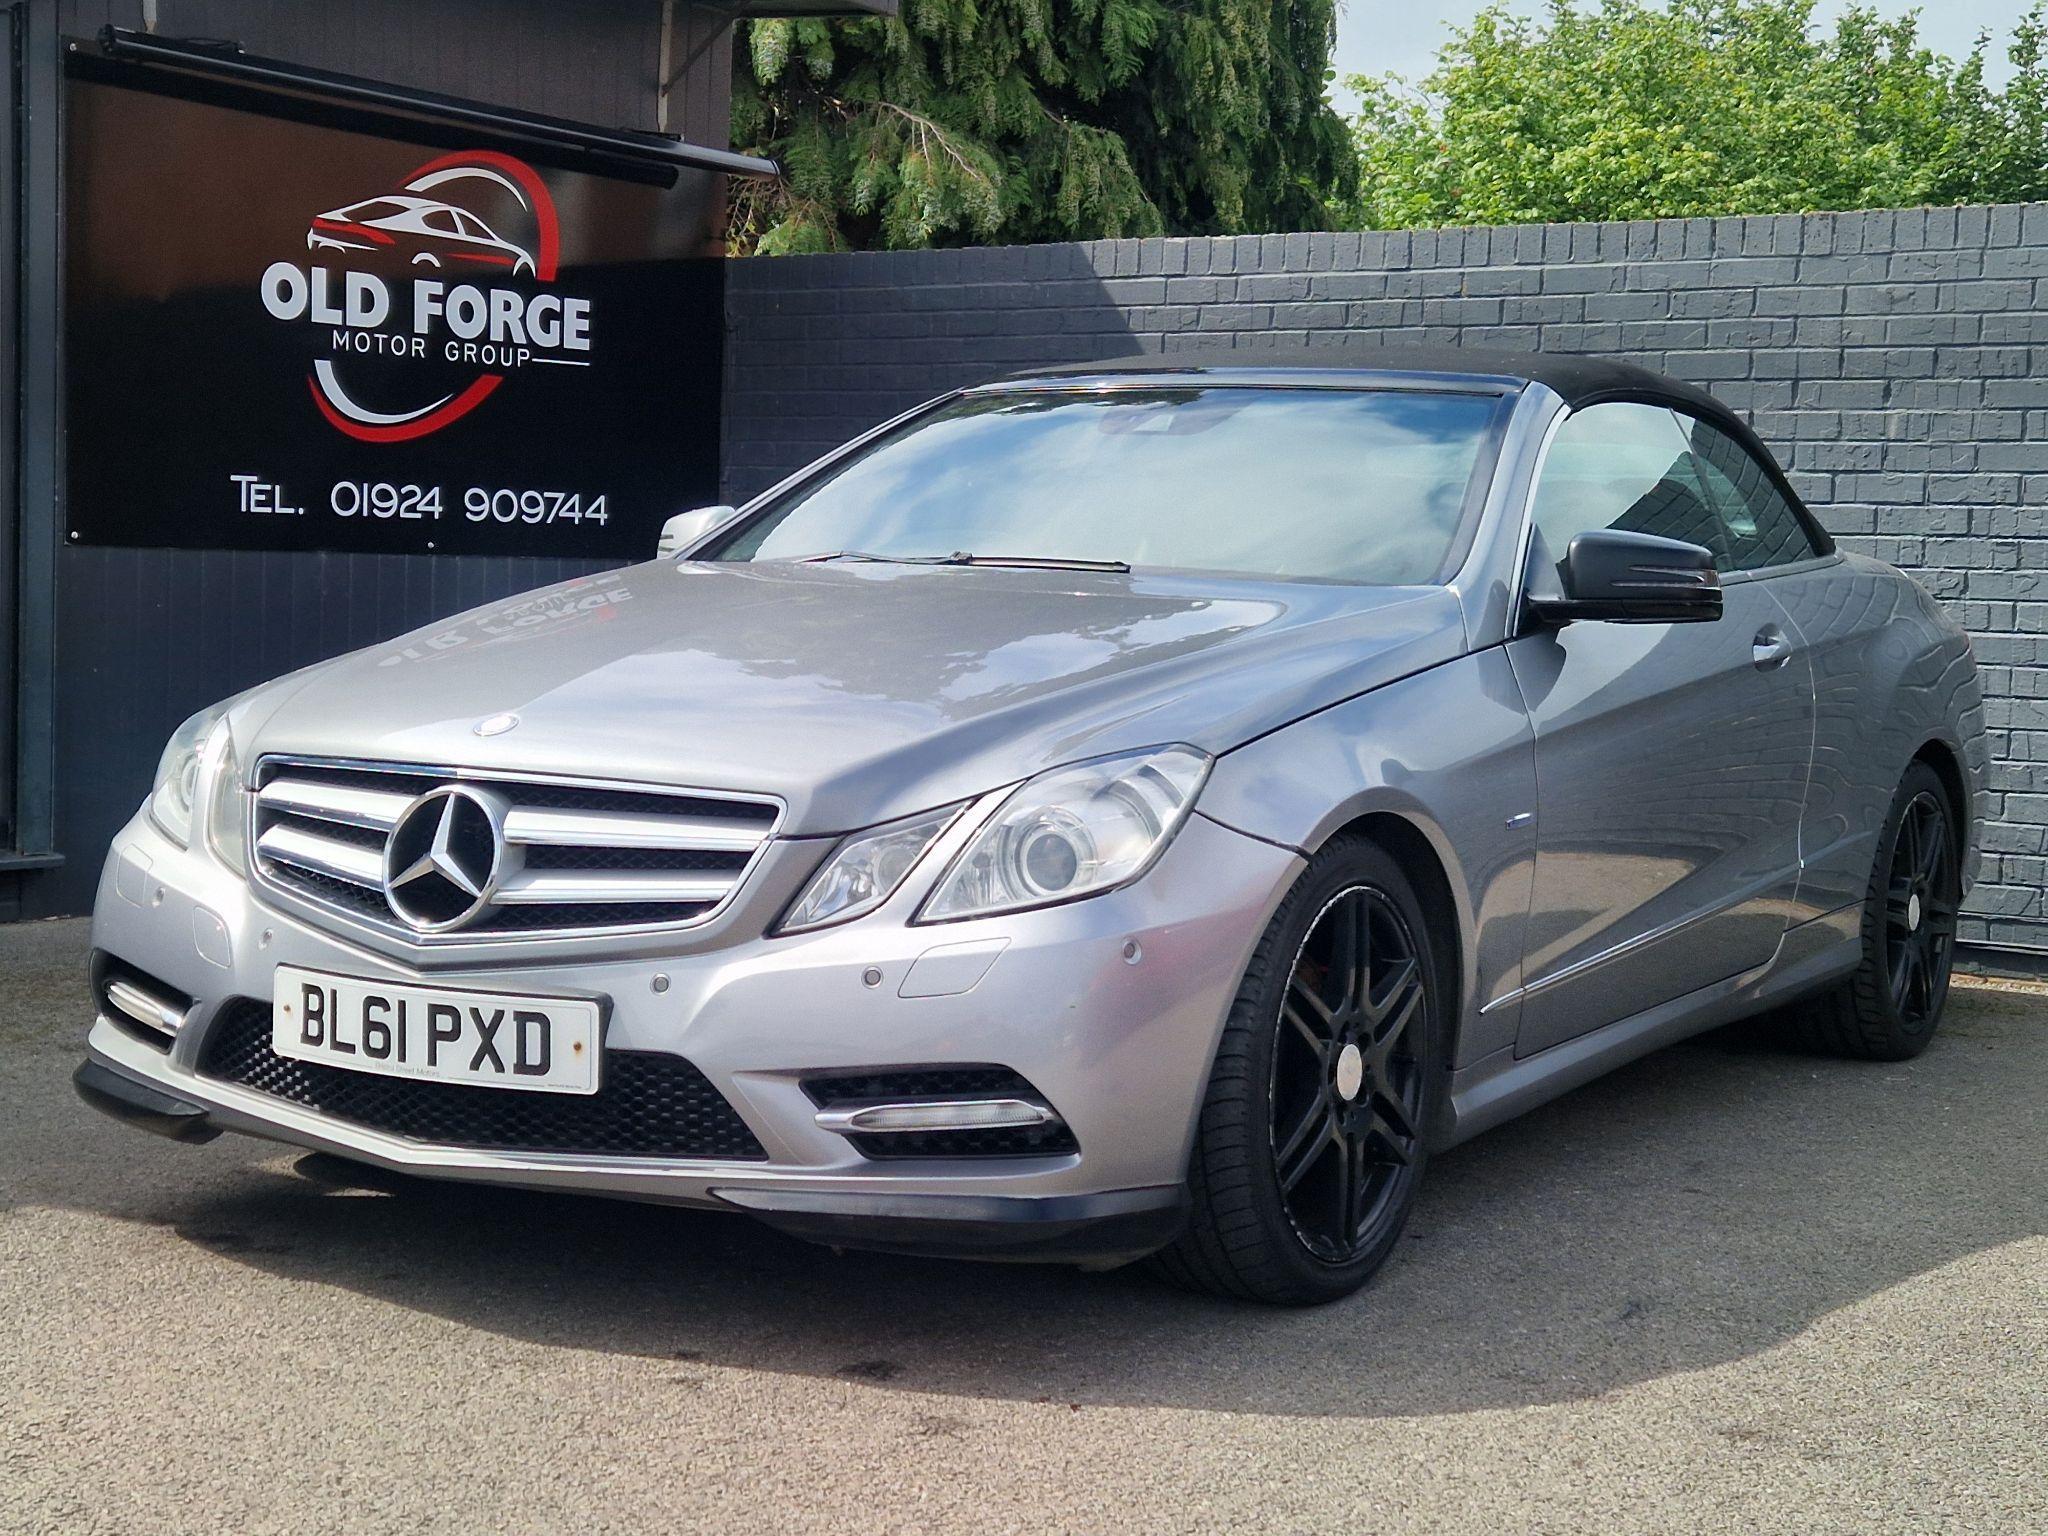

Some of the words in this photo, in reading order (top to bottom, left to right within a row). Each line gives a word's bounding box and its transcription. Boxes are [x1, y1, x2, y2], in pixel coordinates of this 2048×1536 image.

[261, 261, 390, 328] OLD
[413, 279, 590, 351] FORGE
[332, 329, 426, 359] MOTOR
[444, 340, 530, 368] GROUP
[330, 481, 443, 520] 01924
[464, 487, 608, 526] 909744
[300, 983, 407, 1063] BL61
[427, 1003, 551, 1077] PXD
